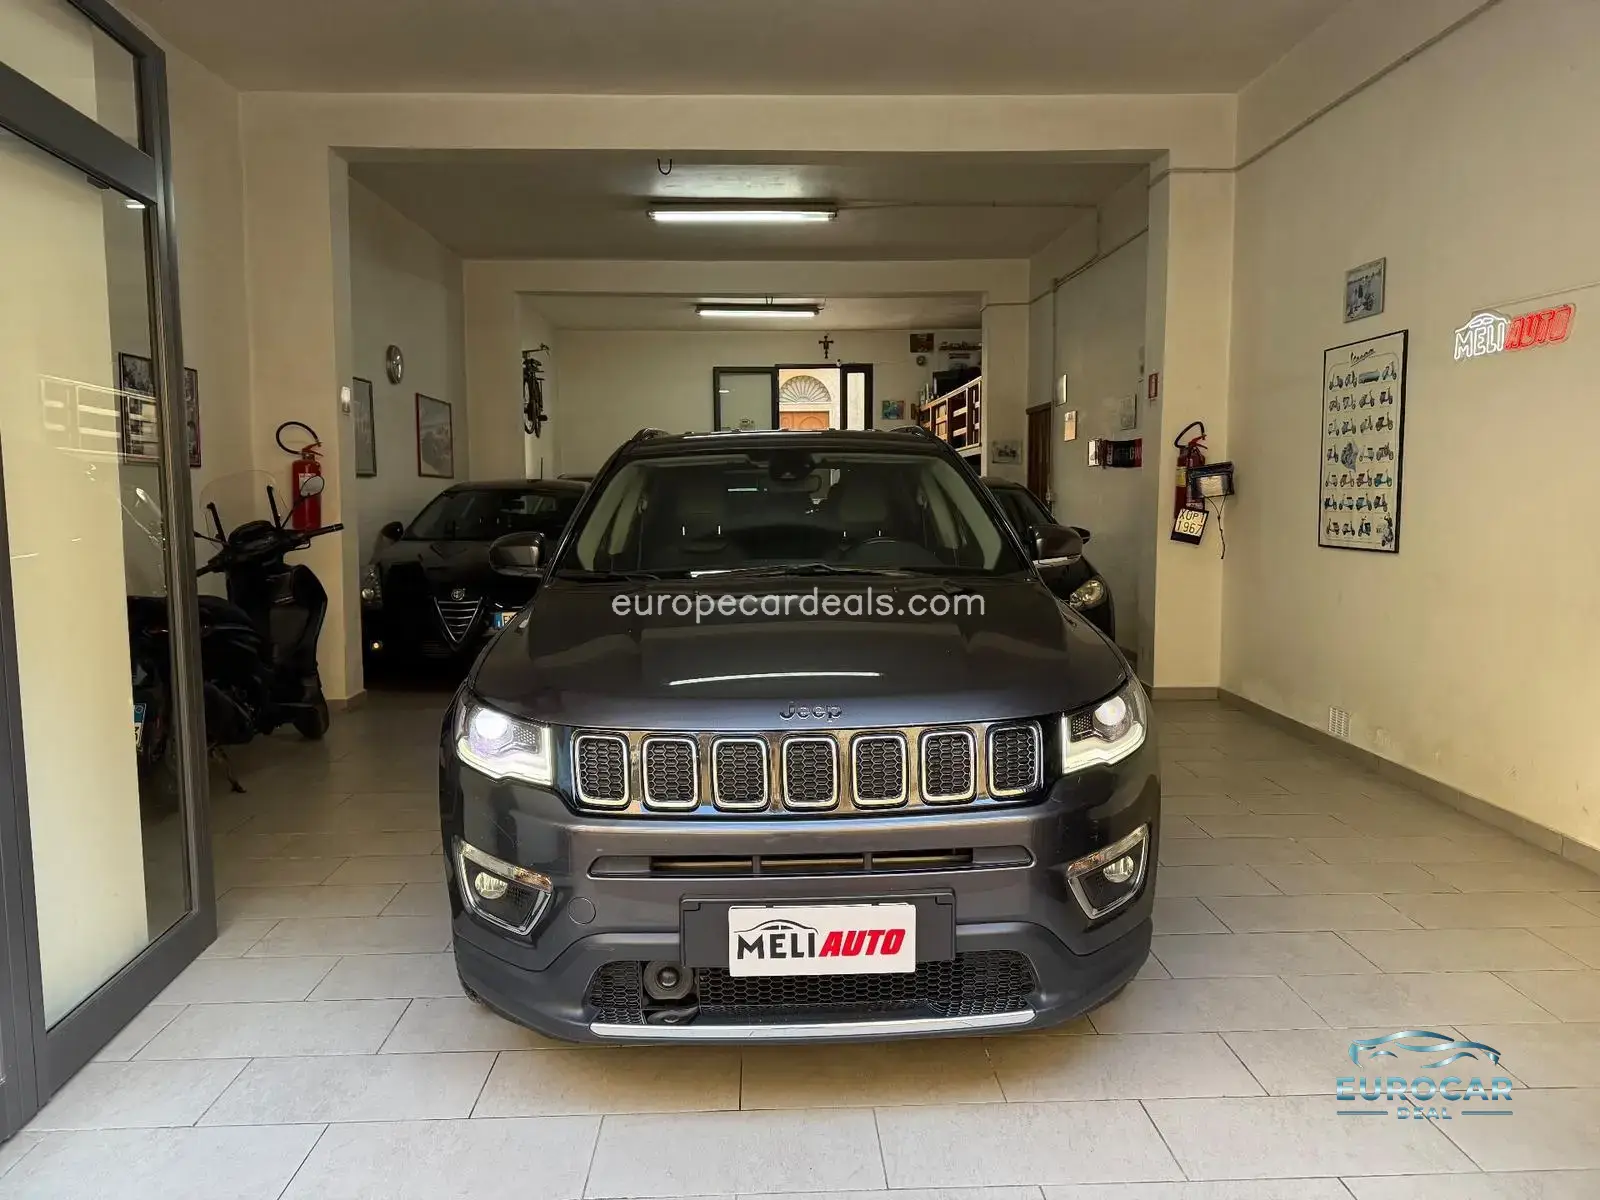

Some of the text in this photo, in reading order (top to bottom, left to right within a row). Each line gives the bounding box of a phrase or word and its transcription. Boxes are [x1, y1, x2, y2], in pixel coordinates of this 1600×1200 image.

[1453, 305, 1572, 360] MELI AUTO
[1177, 520, 1203, 535] 1967
[780, 700, 842, 723] Jeep
[737, 929, 906, 960] MELI AUTO
